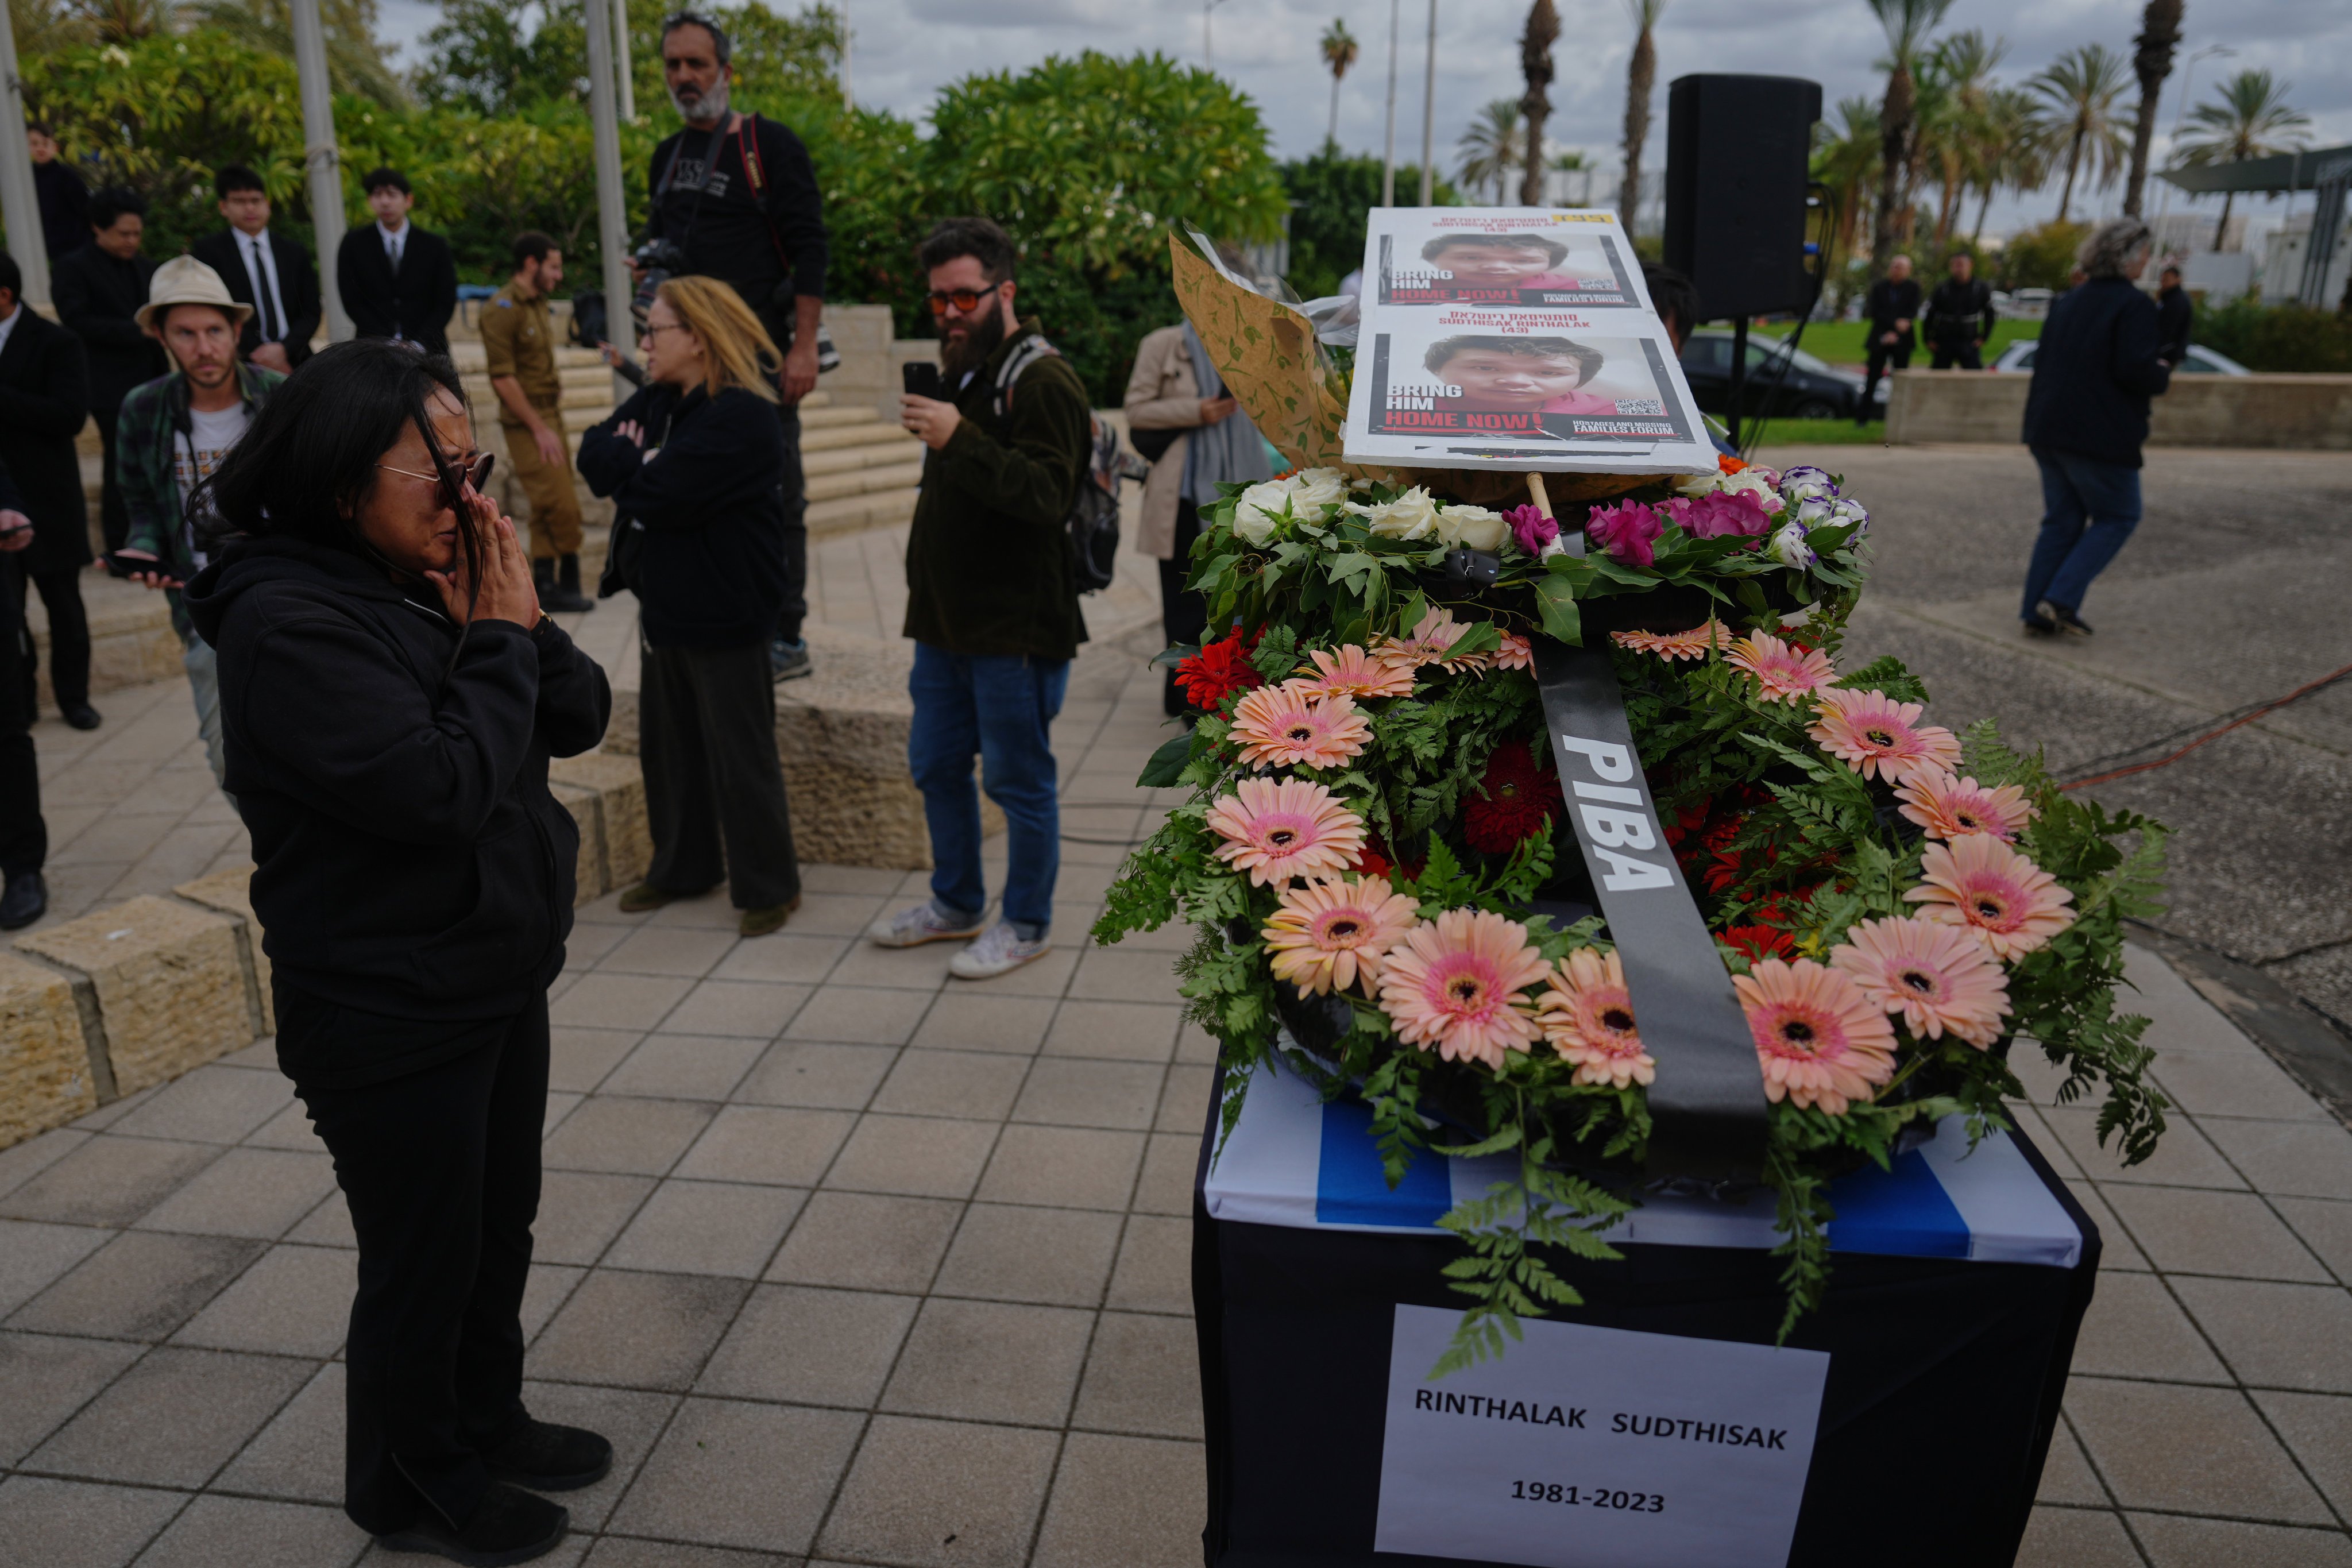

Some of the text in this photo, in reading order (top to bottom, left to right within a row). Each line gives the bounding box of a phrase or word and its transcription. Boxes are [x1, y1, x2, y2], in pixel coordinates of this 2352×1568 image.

[1392, 270, 1454, 280] BRING
[1391, 280, 1431, 289] HIM
[1391, 288, 1451, 299] HOME
[1450, 311, 1504, 319] רינטלאק
[1439, 318, 1512, 326] SUDTHISAK
[1387, 385, 1462, 397] BRING
[1386, 396, 1434, 410] HIM
[1385, 411, 1458, 426] HOME
[1630, 426, 1674, 434] FORUM
[1562, 735, 1675, 891] PIBA
[1415, 1388, 1788, 1451] RINTHALAK SUDTHISAK
[1511, 1480, 1665, 1514] 1981-2023
